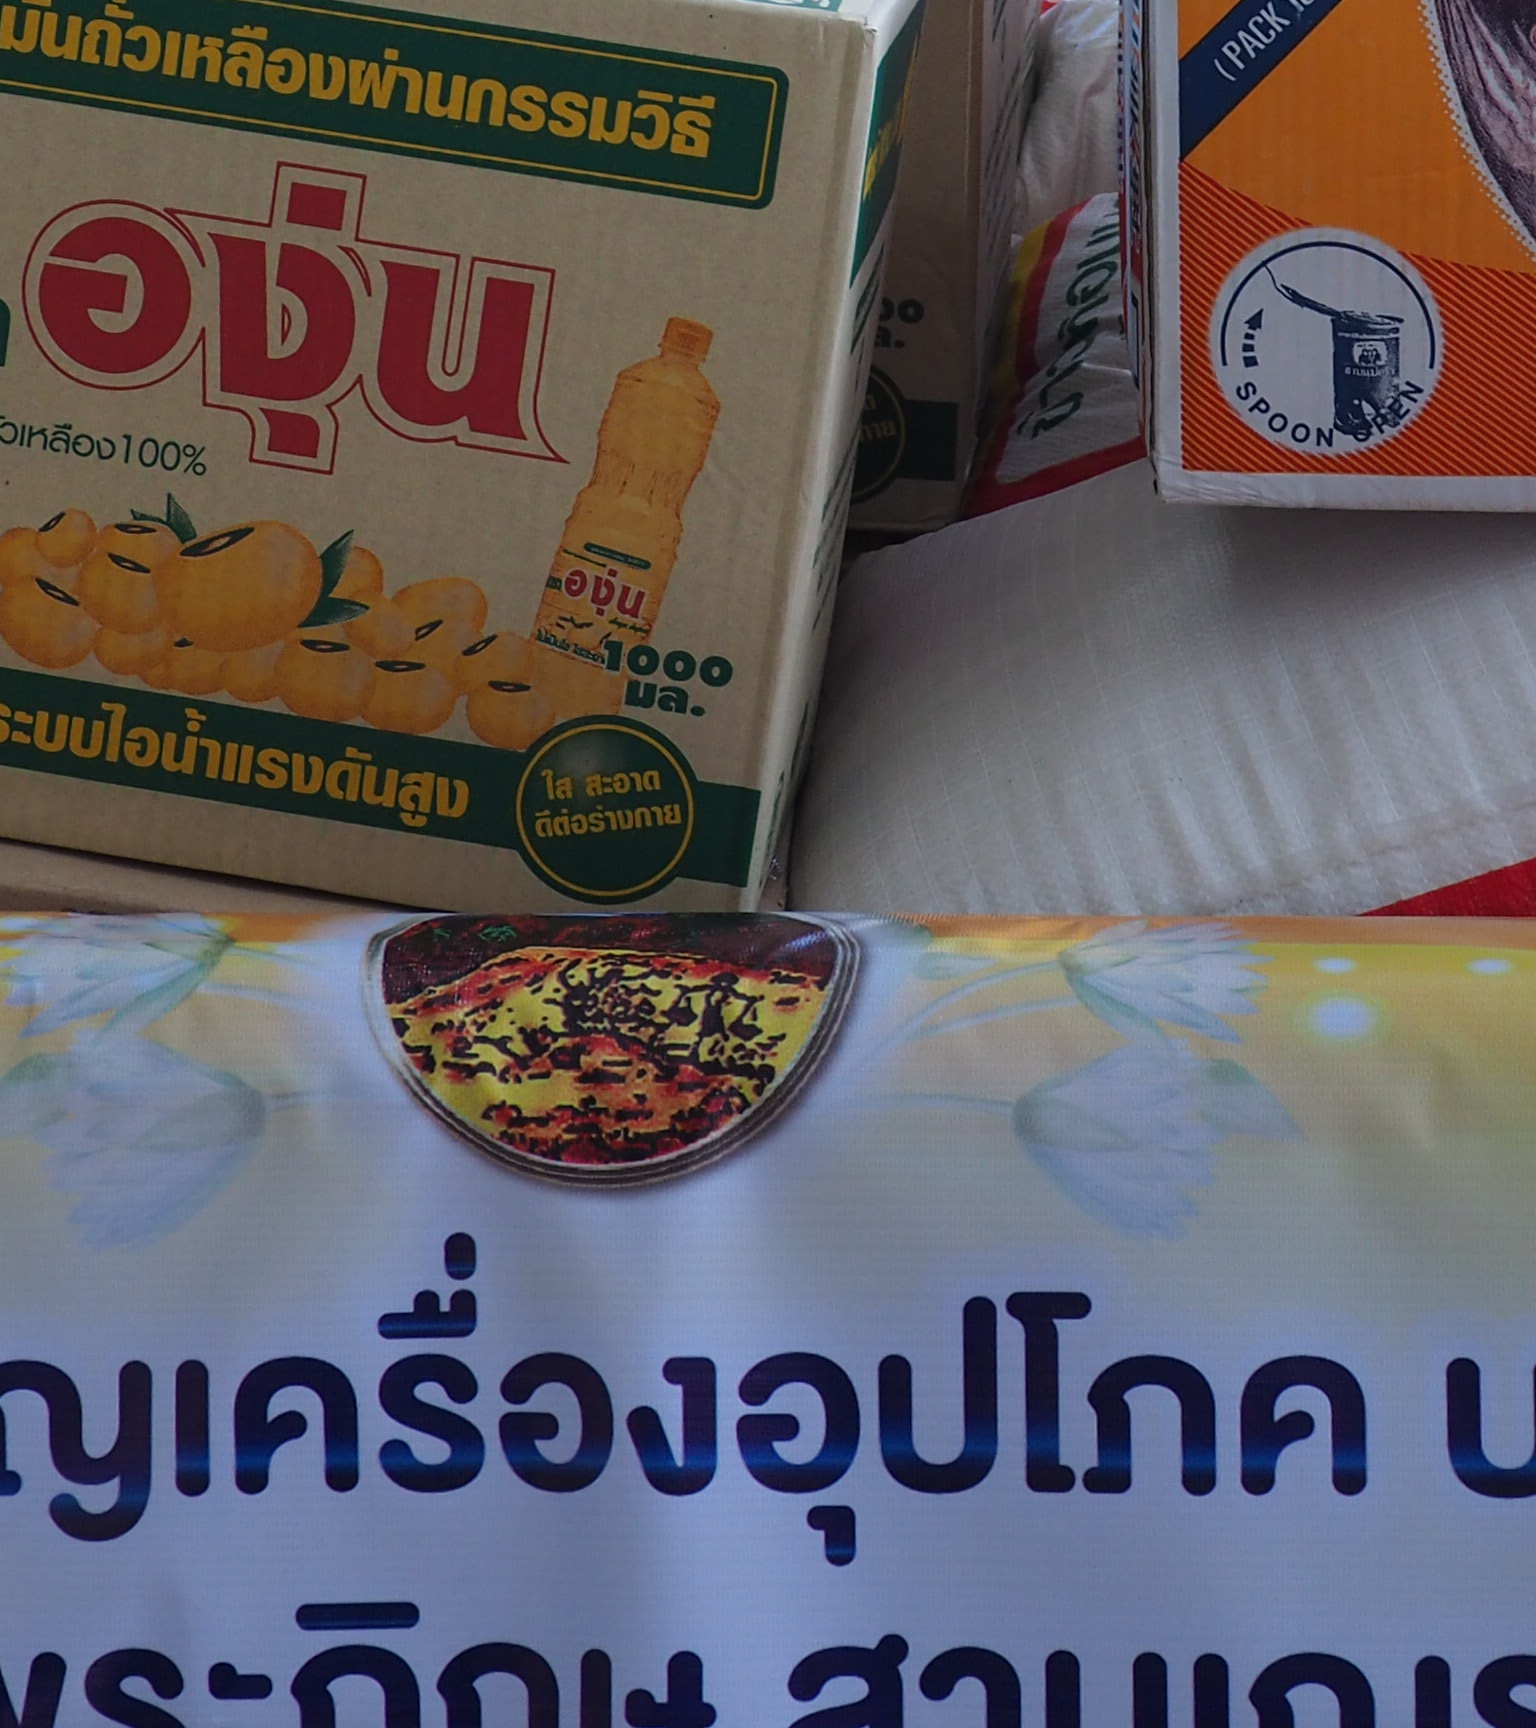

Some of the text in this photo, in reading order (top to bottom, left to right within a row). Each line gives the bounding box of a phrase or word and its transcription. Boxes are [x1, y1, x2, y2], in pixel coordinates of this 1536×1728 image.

[24, 162, 568, 474] องุ่น
[1235, 381, 1334, 447] SPOON
[562, 562, 646, 624] องุ่น
[601, 638, 733, 683] 1000
[624, 681, 707, 720] มล.
[541, 769, 661, 800] ใส สะอาด
[535, 804, 682, 838] ดีต่อร่างกาย
